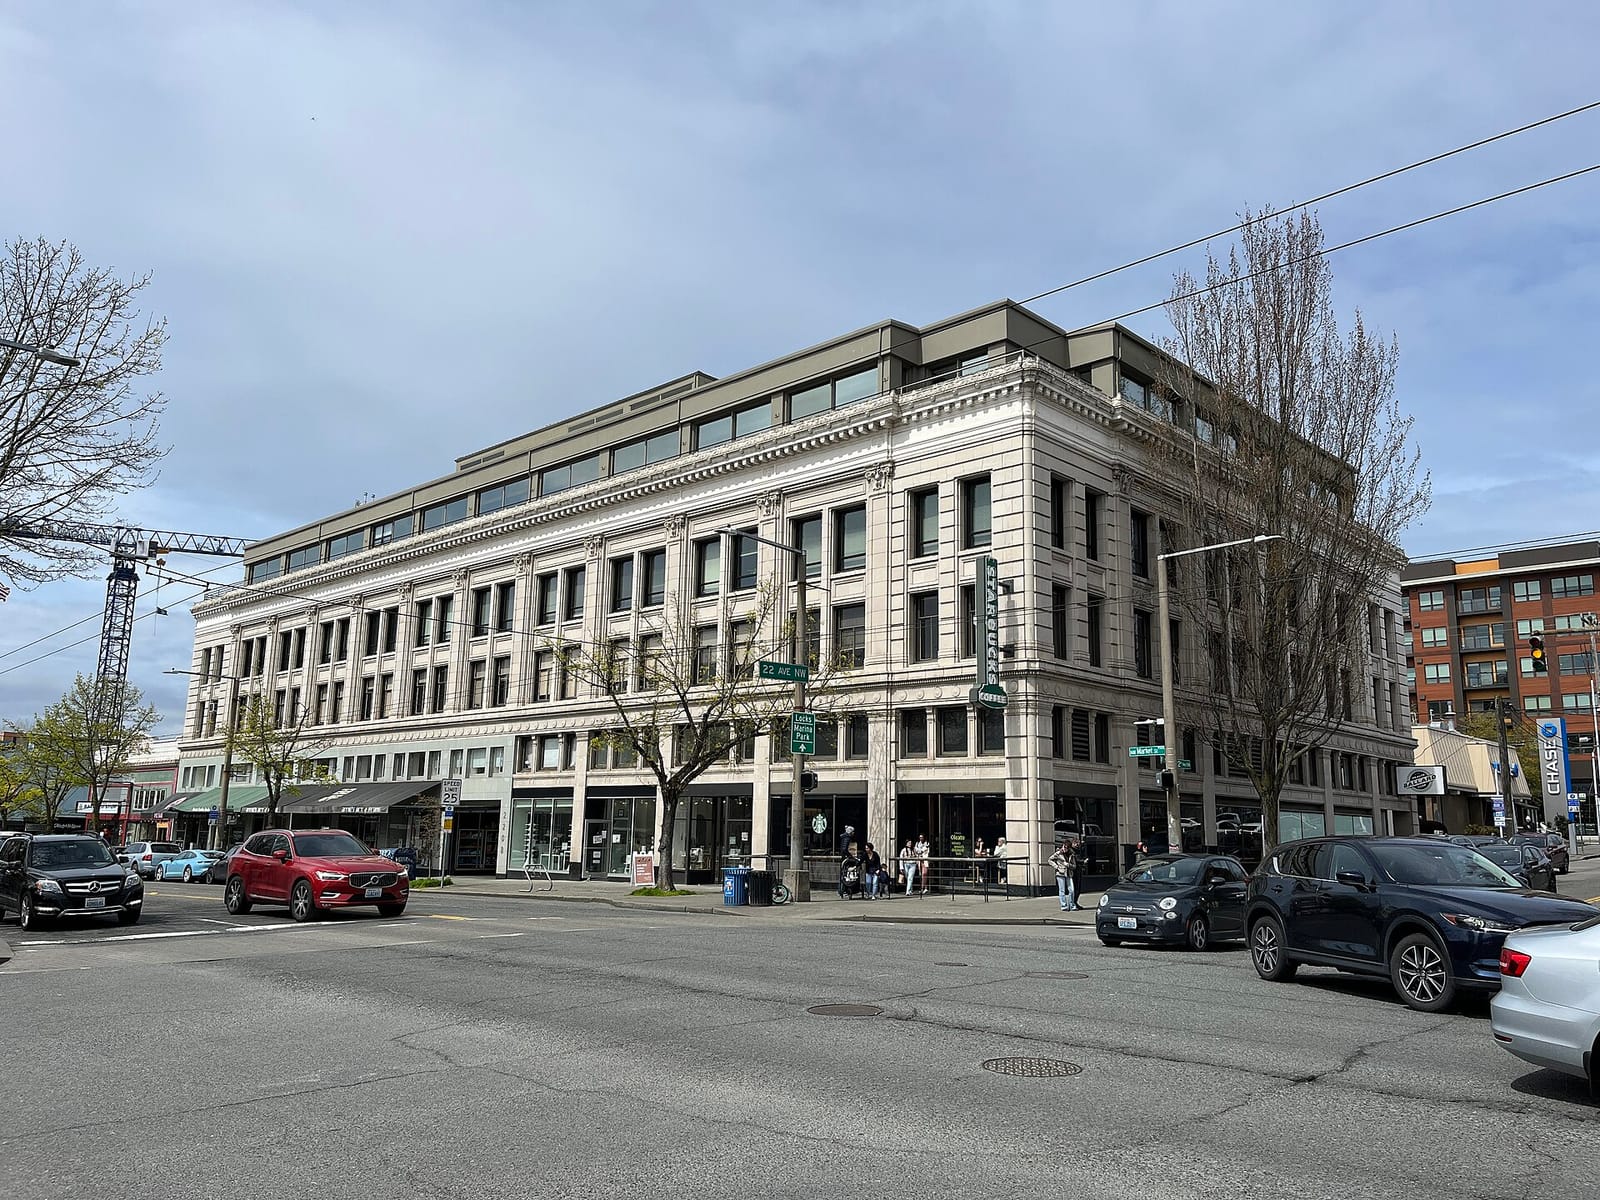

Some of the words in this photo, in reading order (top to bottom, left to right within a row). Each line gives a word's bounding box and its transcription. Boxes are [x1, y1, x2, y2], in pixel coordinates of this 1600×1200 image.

[987, 565, 999, 685] STARBUCKS
[762, 664, 775, 675] 22
[777, 667, 791, 676] AVE
[794, 668, 807, 678] NW
[980, 691, 1007, 704] COFFEE
[795, 714, 812, 723] Locks
[793, 724, 813, 733] Marina
[796, 732, 810, 741] Park
[1544, 739, 1560, 795] CHASE
[1403, 774, 1437, 789] BALLARD
[443, 793, 458, 804] 25
